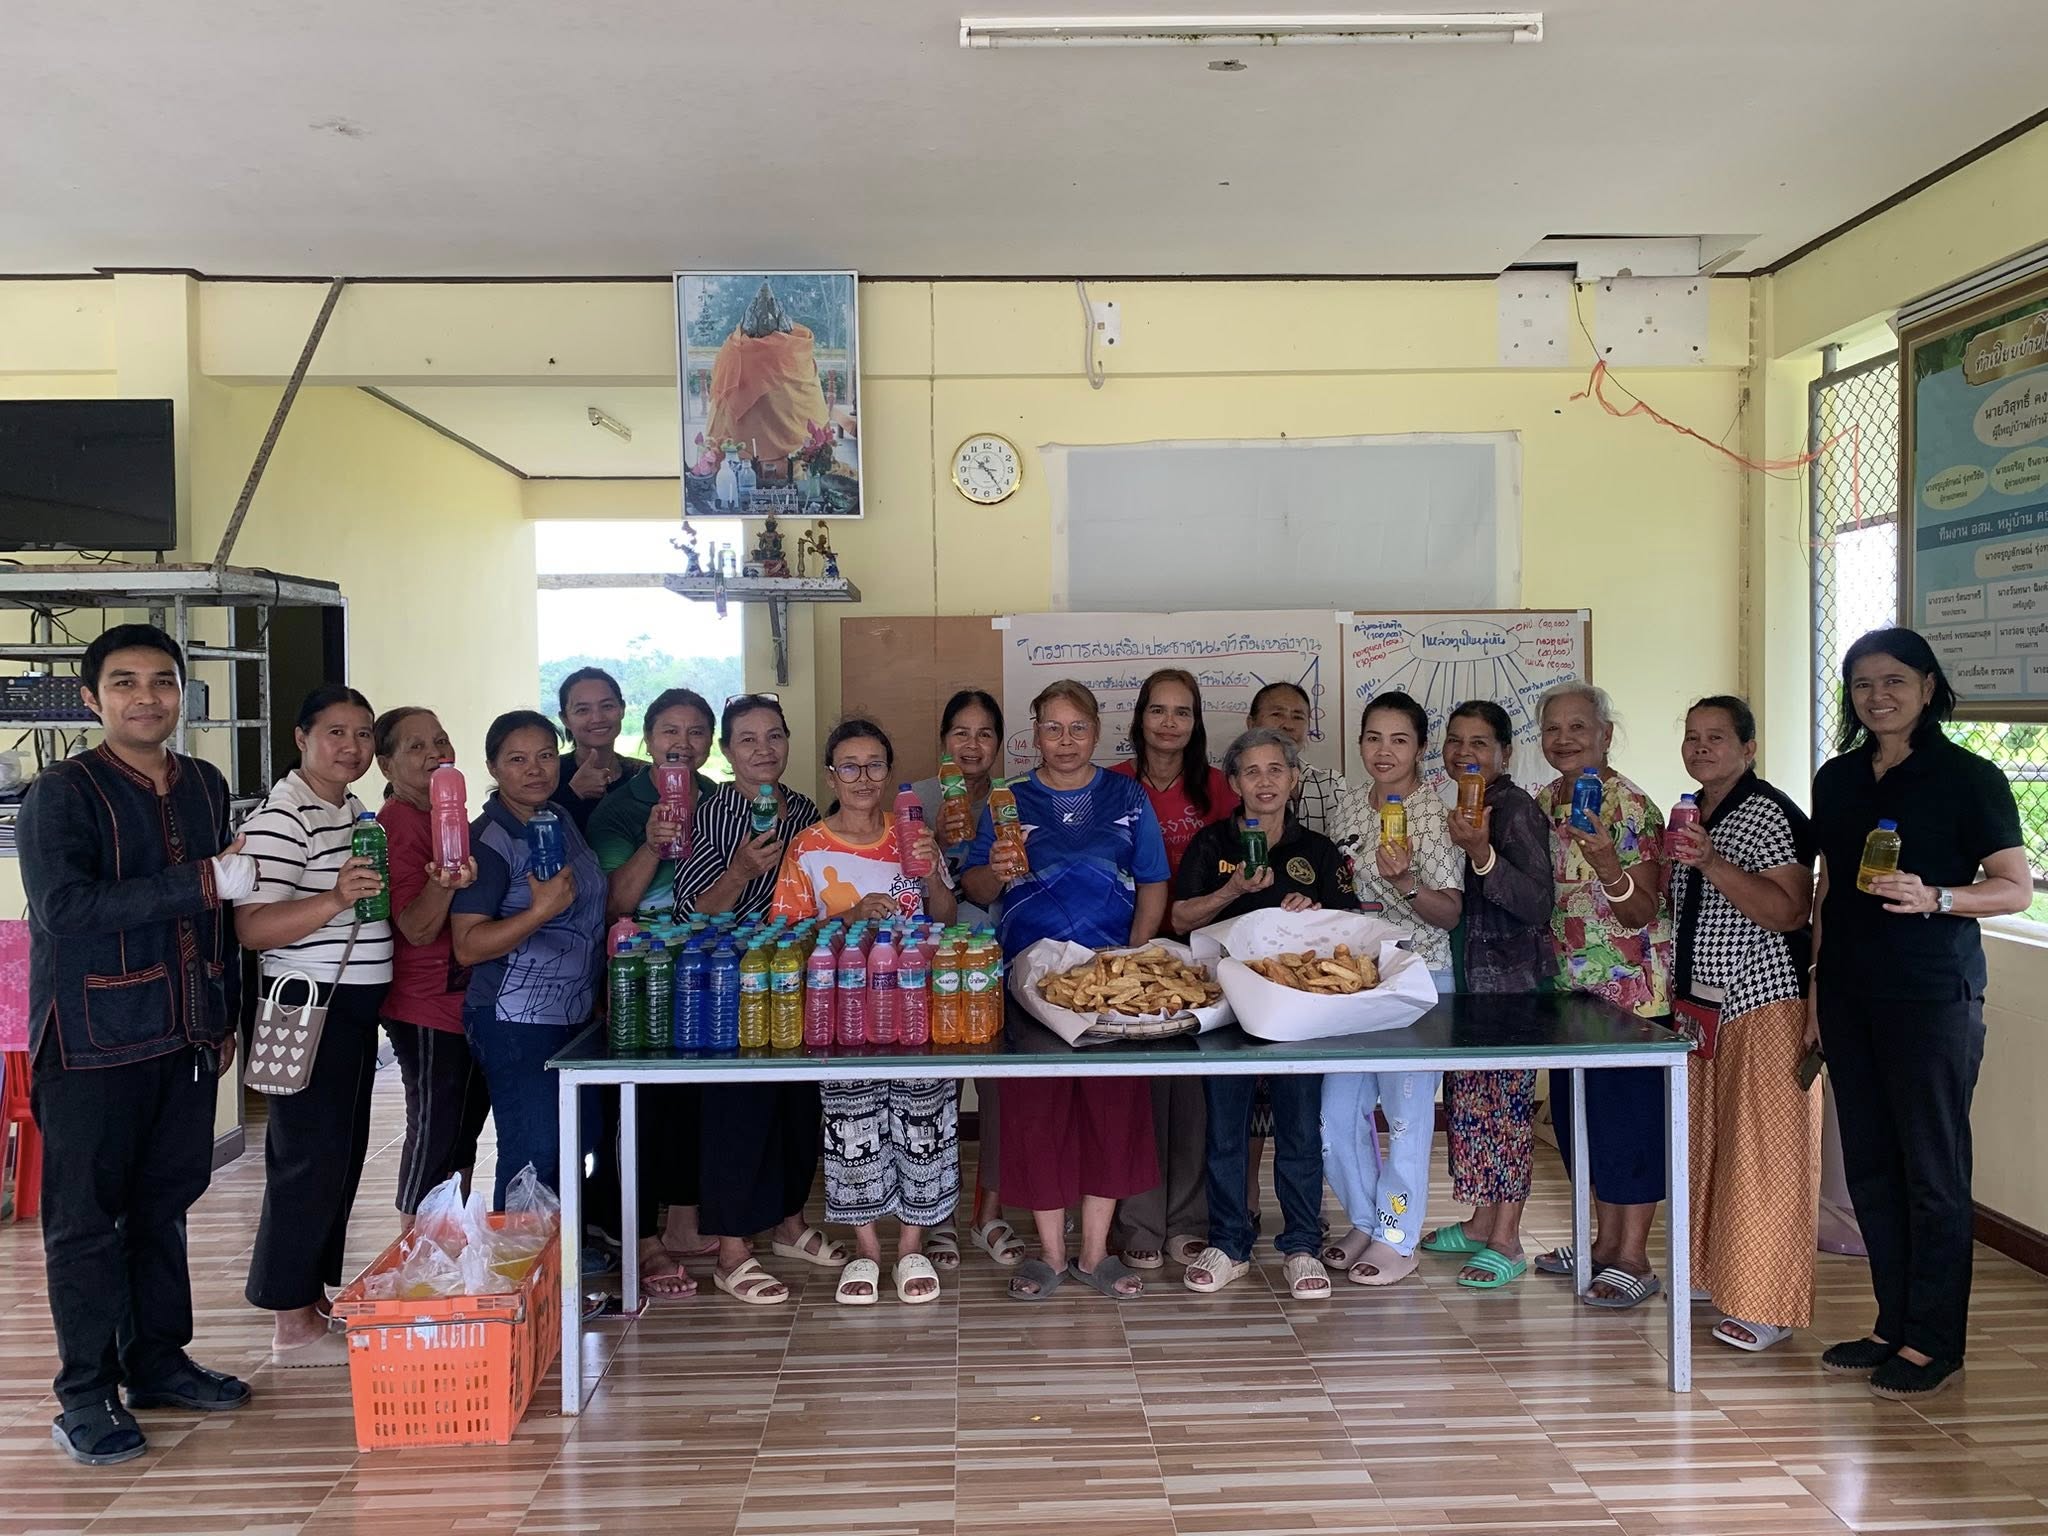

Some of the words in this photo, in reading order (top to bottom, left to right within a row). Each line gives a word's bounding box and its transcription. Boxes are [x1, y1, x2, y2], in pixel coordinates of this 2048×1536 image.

[1985, 388, 2031, 420] นายวิสุทธิ์
[982, 442, 992, 450] 12
[1005, 454, 1011, 462] 2
[1007, 466, 1014, 474] 3
[1938, 525, 1968, 541] ทีมงาน
[1971, 521, 1994, 535] อสม.
[1998, 511, 2033, 533] หมู่บ้าน
